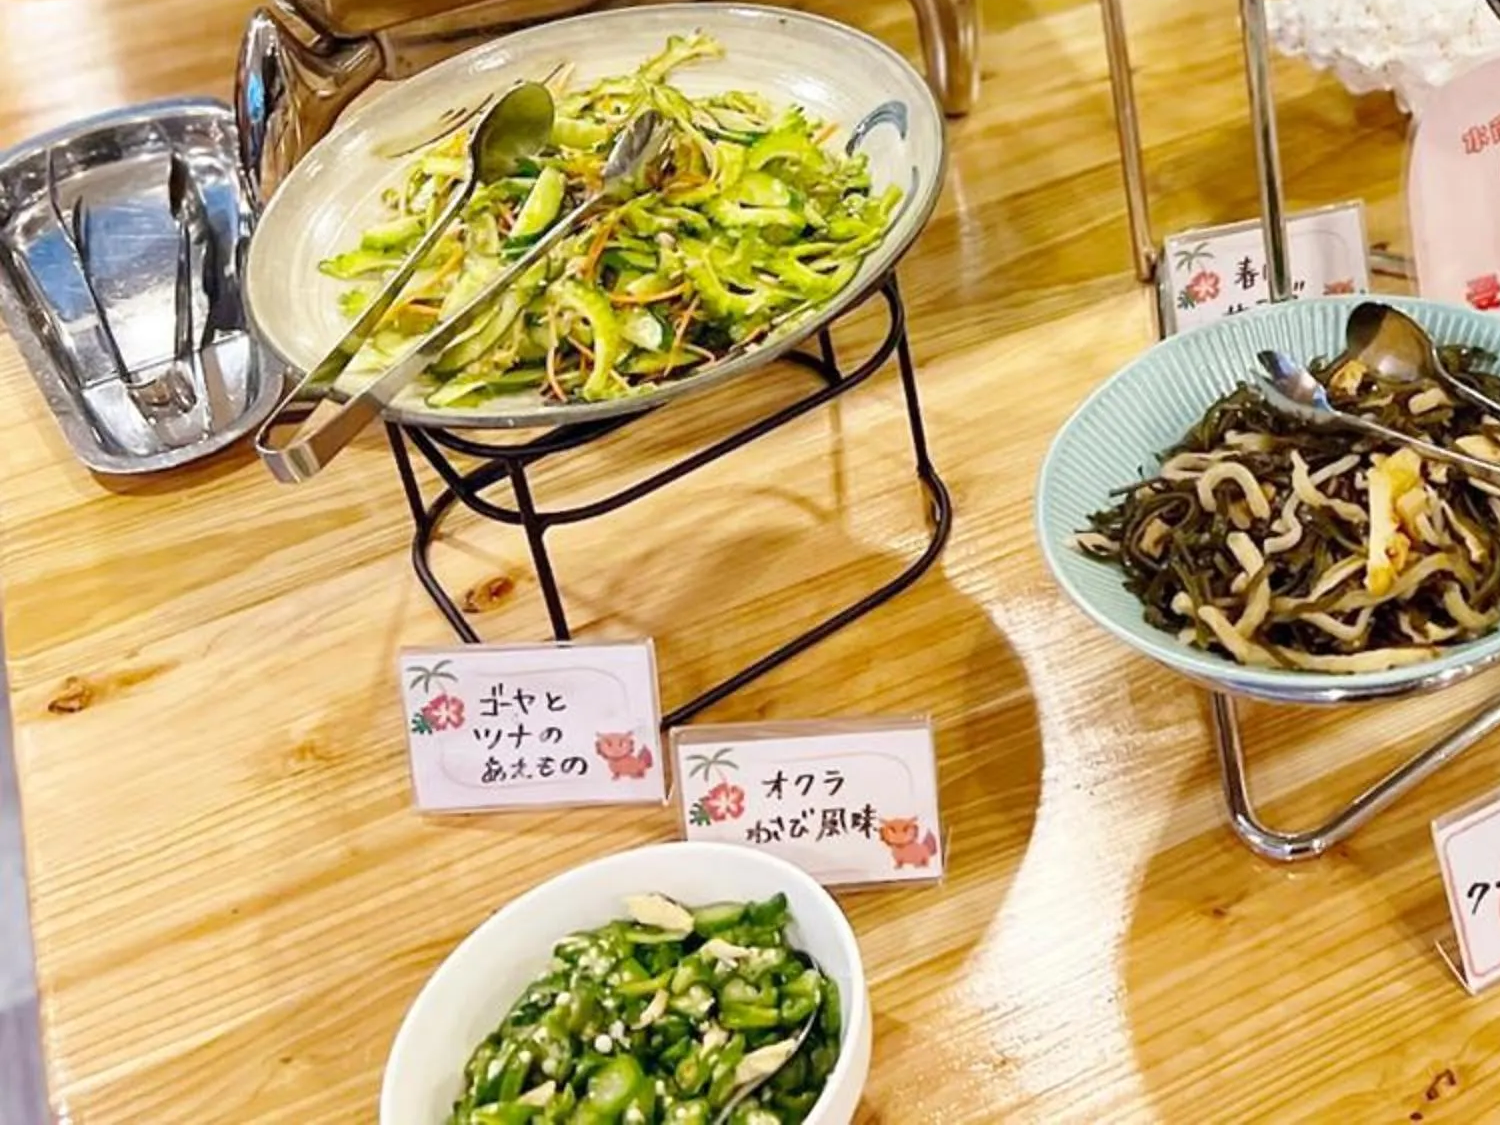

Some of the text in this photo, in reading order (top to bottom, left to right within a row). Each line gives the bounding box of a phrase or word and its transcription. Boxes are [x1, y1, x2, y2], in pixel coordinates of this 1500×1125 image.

[479, 681, 567, 717] ゴーヤと
[472, 722, 563, 751] ツナの
[481, 755, 589, 784] あえもの
[761, 770, 846, 800] オクラ
[745, 802, 879, 845] わさび風味
